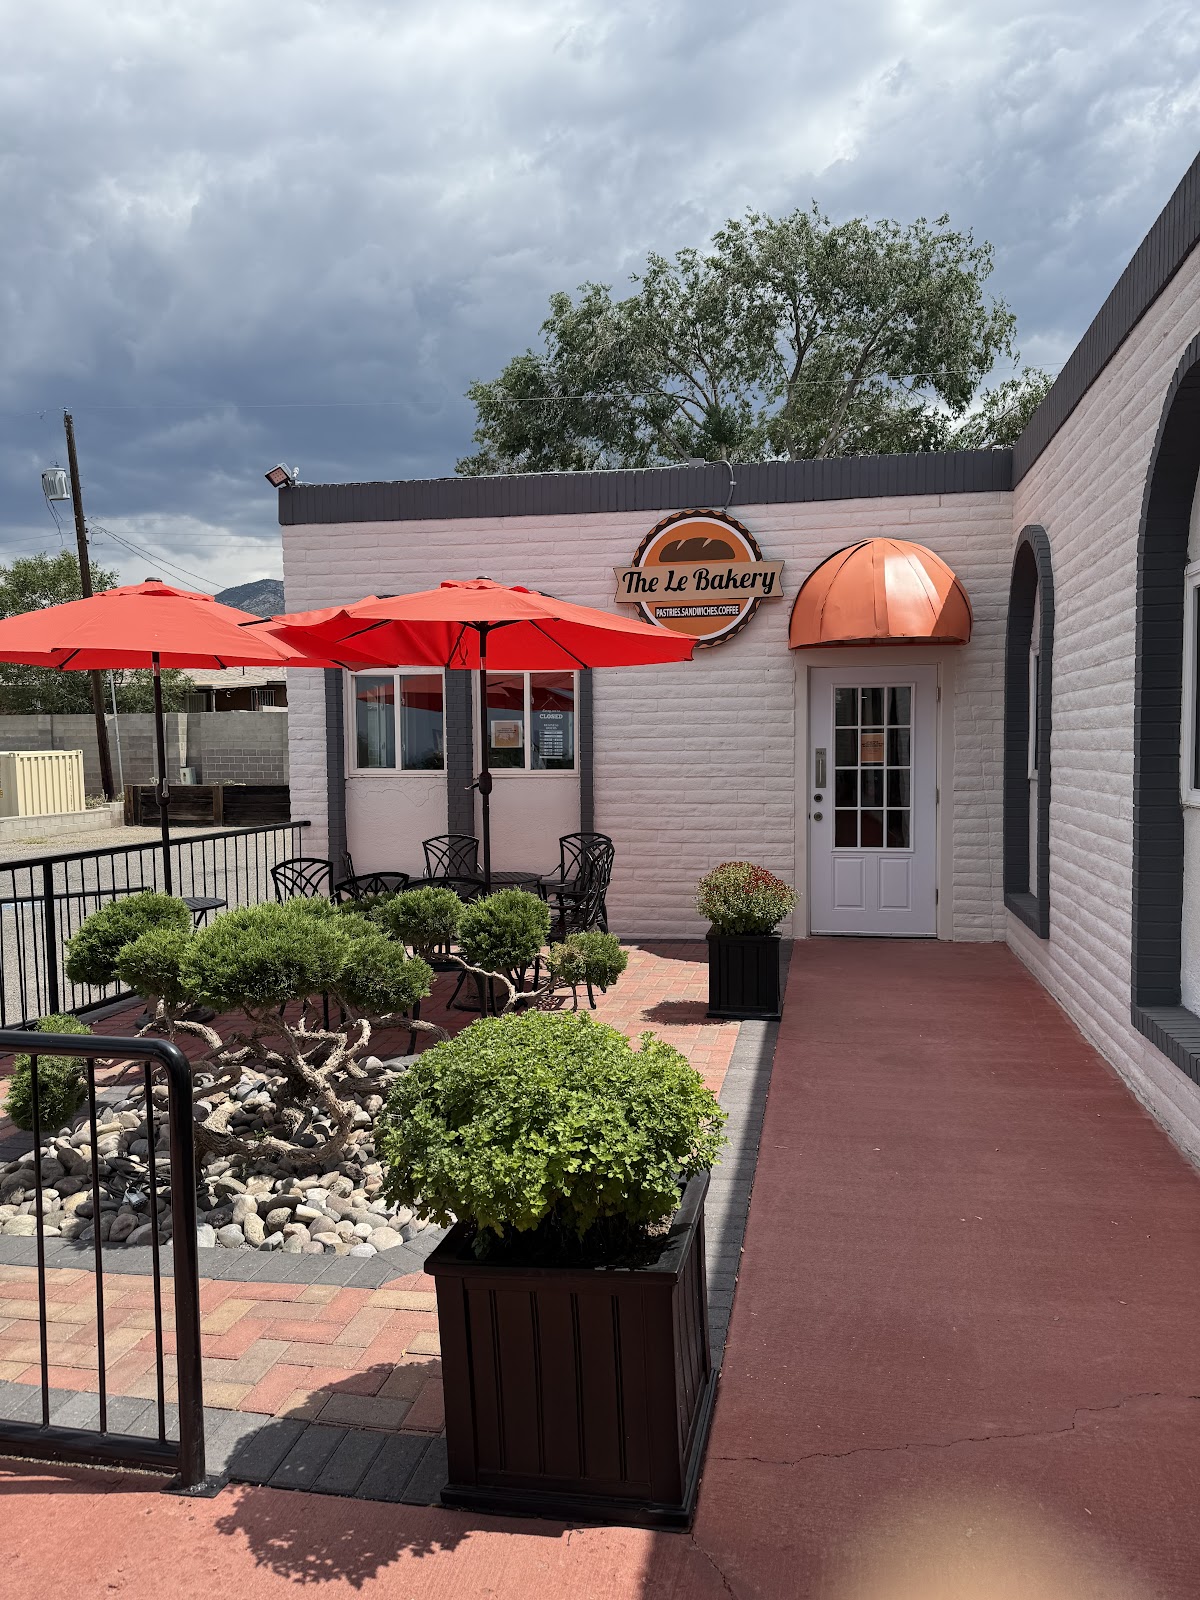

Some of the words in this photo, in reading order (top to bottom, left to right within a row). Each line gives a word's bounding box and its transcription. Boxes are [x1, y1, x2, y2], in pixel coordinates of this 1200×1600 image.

[622, 571, 659, 594] The
[664, 570, 688, 592] Le
[692, 567, 776, 595] Bakery
